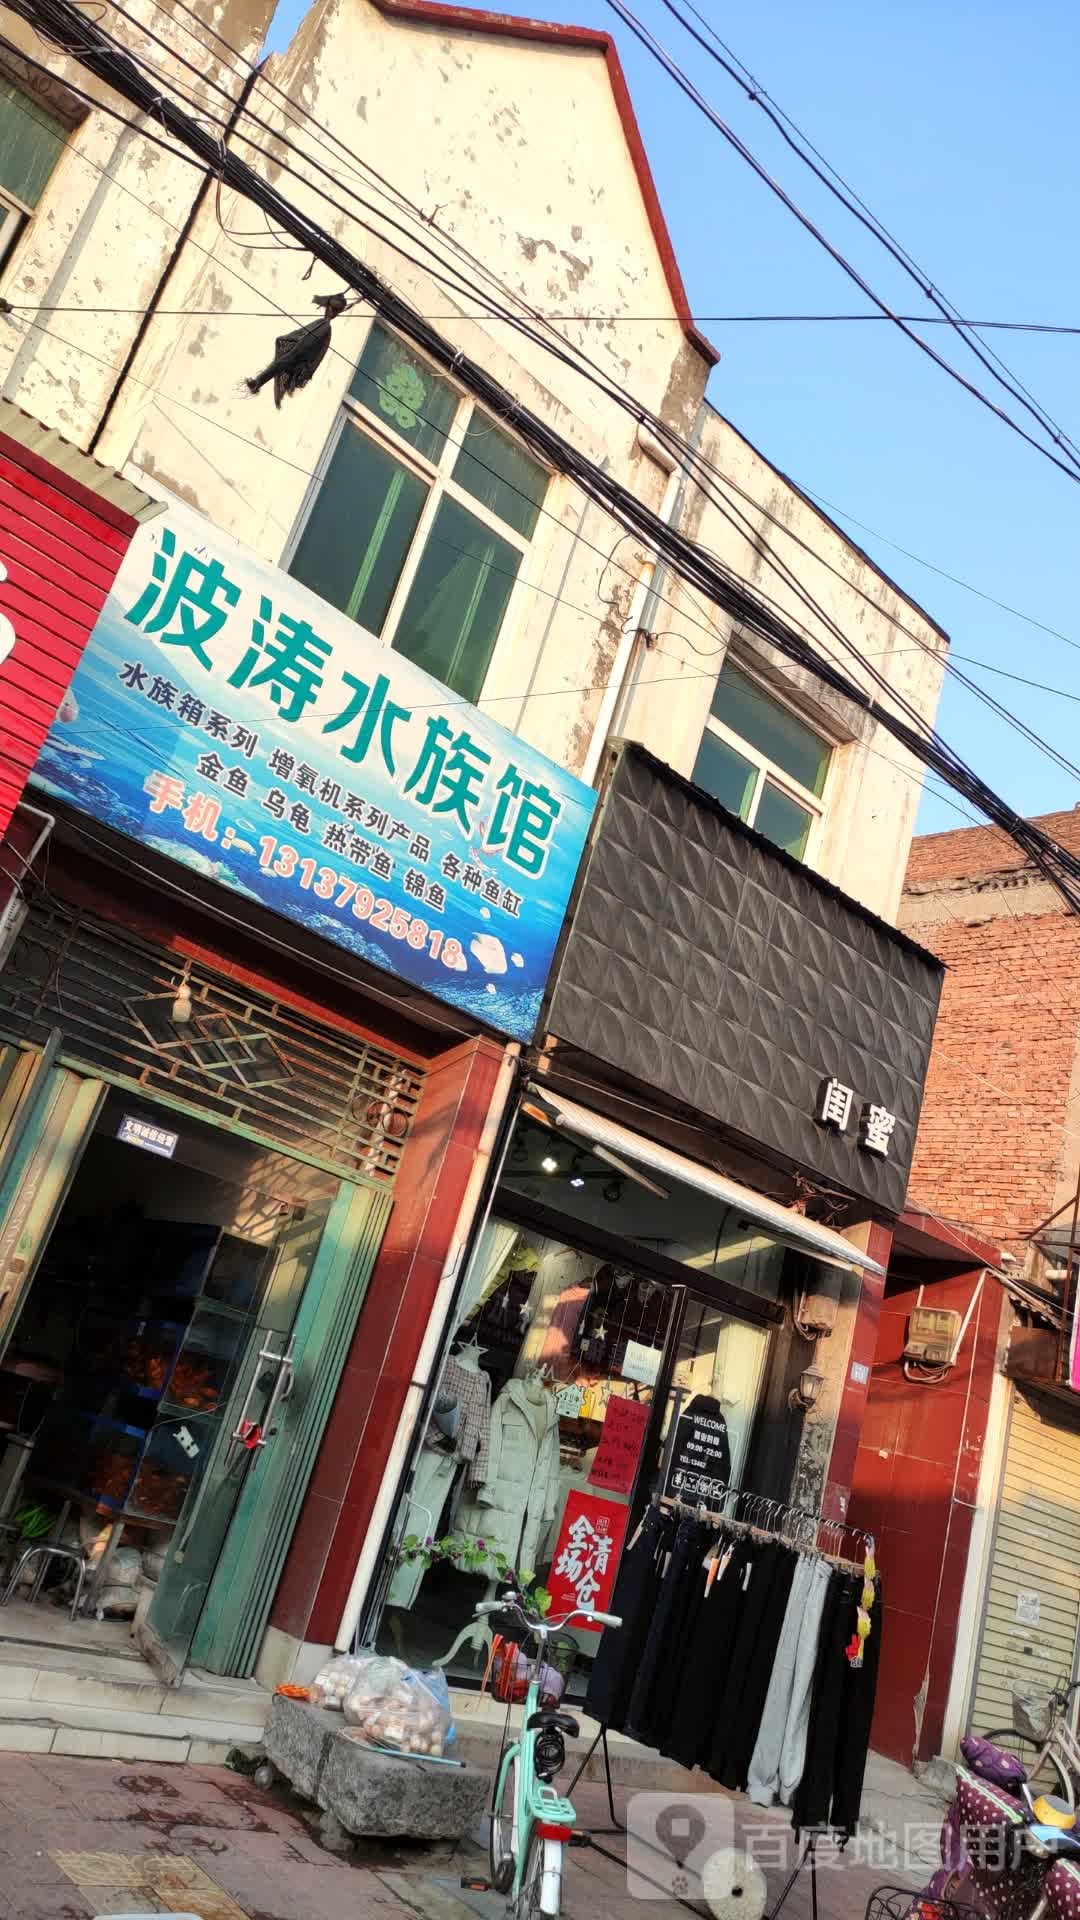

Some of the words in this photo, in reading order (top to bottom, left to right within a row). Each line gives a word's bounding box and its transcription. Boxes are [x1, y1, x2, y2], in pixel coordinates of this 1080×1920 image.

[123, 527, 562, 875] 波涛水族馆
[119, 662, 259, 758] 水族箱系列
[268, 748, 431, 862] 增氧机系列产品
[441, 854, 523, 917] 各种鱼缸
[196, 752, 249, 798] 金鱼
[262, 788, 311, 834] 乌龟
[322, 823, 393, 881] 热带鱼
[403, 868, 446, 912] 锦鱼
[821, 1077, 896, 1157] 闺蜜
[693, 1415, 727, 1433] WELCOME
